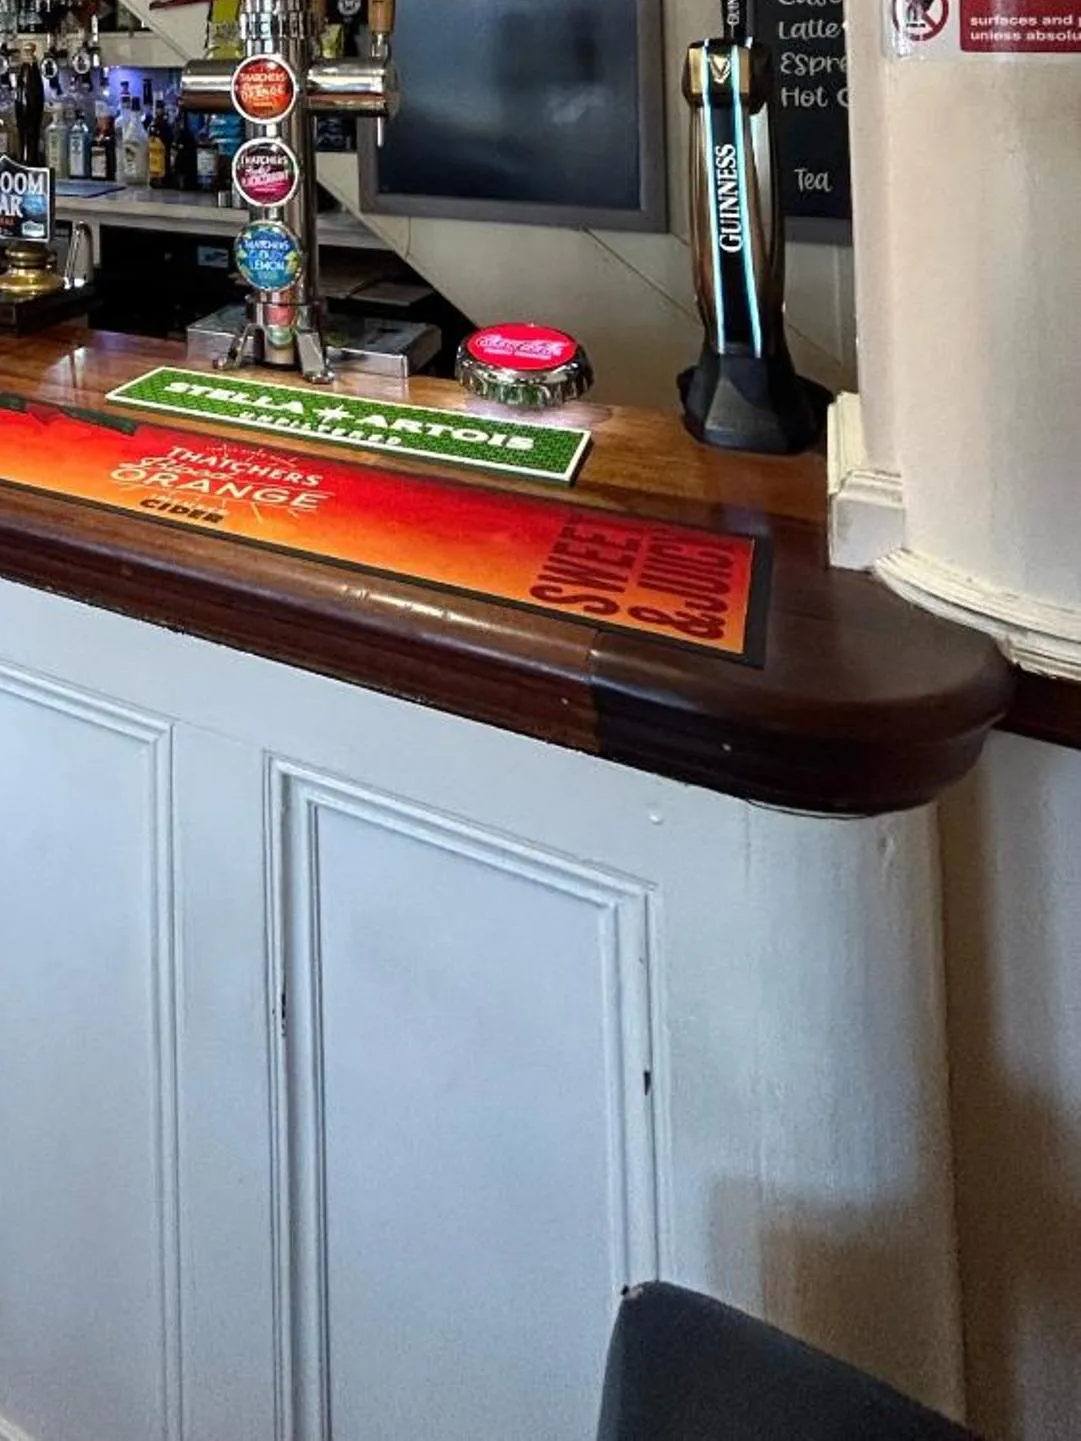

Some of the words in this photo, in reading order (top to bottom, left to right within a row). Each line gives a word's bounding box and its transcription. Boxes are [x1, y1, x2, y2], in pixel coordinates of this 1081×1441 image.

[779, 19, 841, 40] Latte
[969, 15, 1038, 26] surfaces
[1042, 13, 1073, 25] and
[970, 30, 1022, 40] unless
[781, 85, 829, 108] Hot
[794, 168, 833, 193] Tea
[715, 144, 745, 253] GUINNESS
[163, 380, 305, 416] STELLA
[353, 411, 536, 452] ARTOIS
[167, 445, 324, 488] THATCHERS
[109, 466, 333, 510] ORANGE
[138, 498, 225, 525] CIDER
